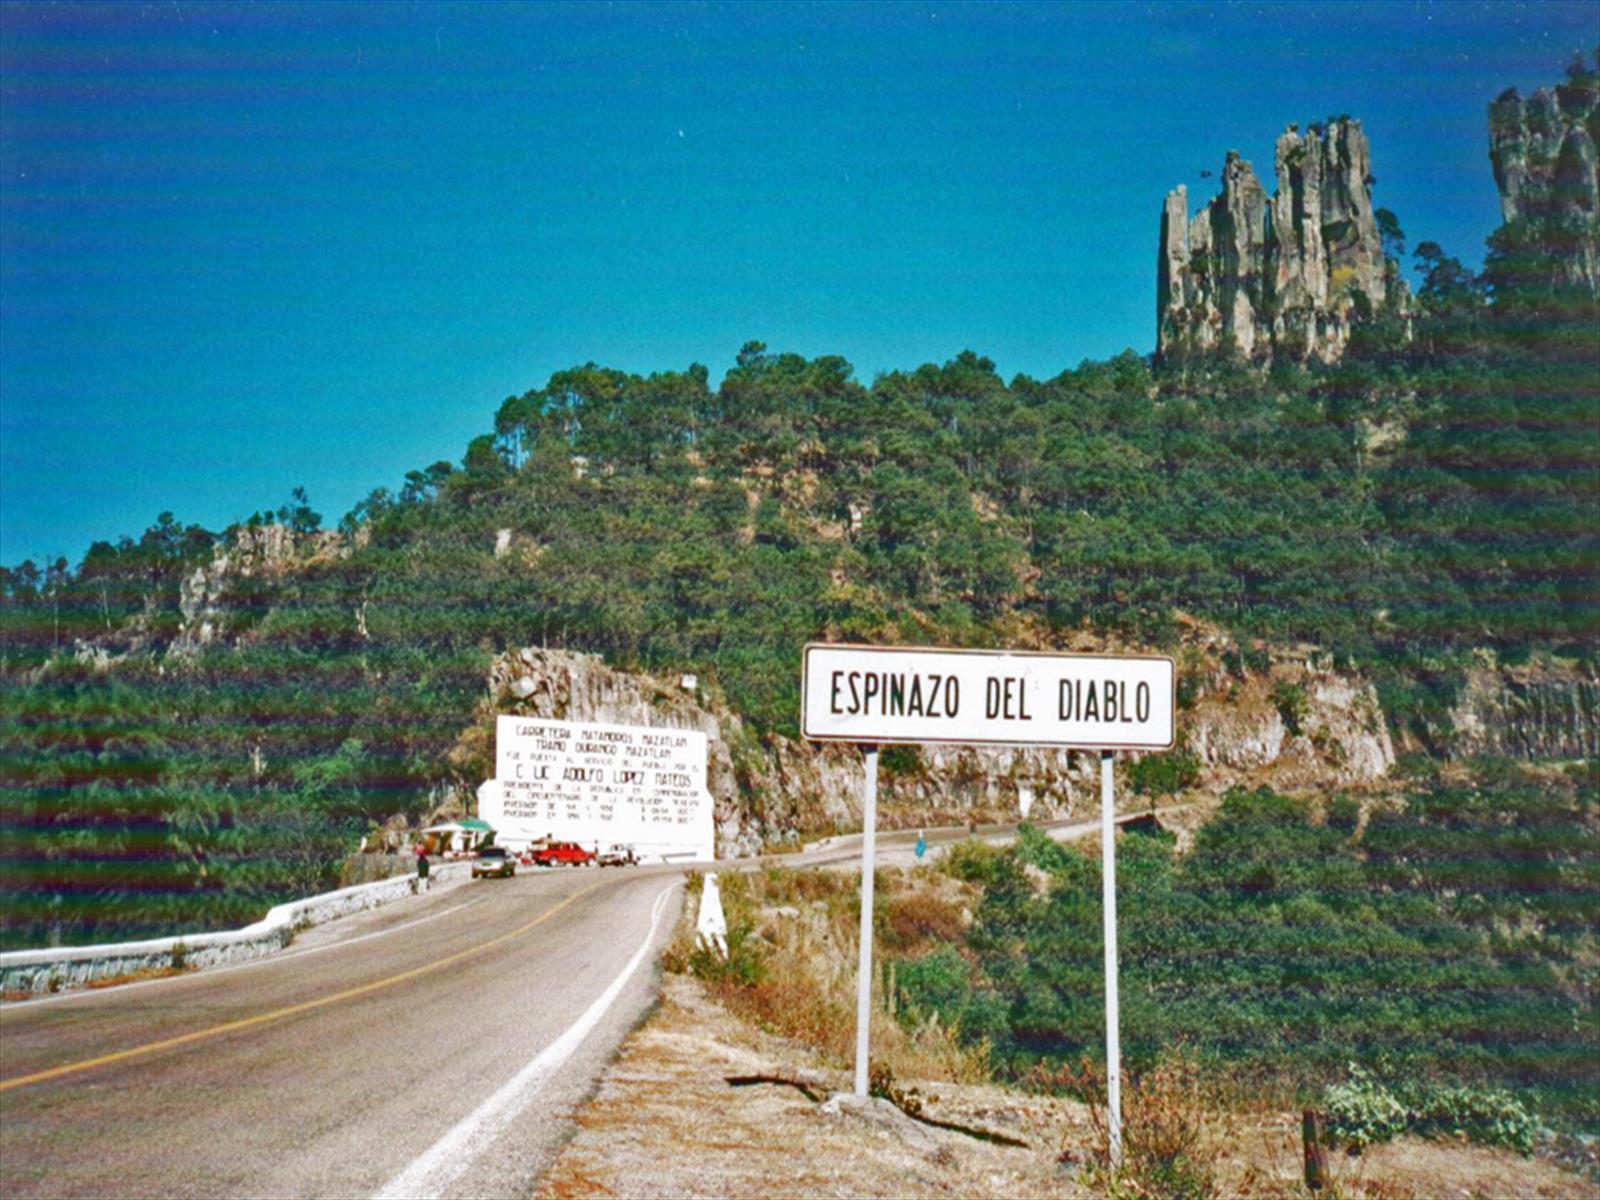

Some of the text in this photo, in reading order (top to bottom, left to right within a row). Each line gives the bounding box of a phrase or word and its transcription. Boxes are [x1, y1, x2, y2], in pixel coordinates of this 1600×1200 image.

[830, 671, 1151, 723] ESPINAZO DEL DIABLO
[515, 724, 687, 748] CARRETERA MATAMOROS MAZATLAN
[536, 739, 671, 759] TRAMO DURANGO MAZATLAN
[563, 766, 604, 783] ADOLFO
[613, 770, 645, 785] LOPEZ
[655, 772, 692, 788] MATEOS
